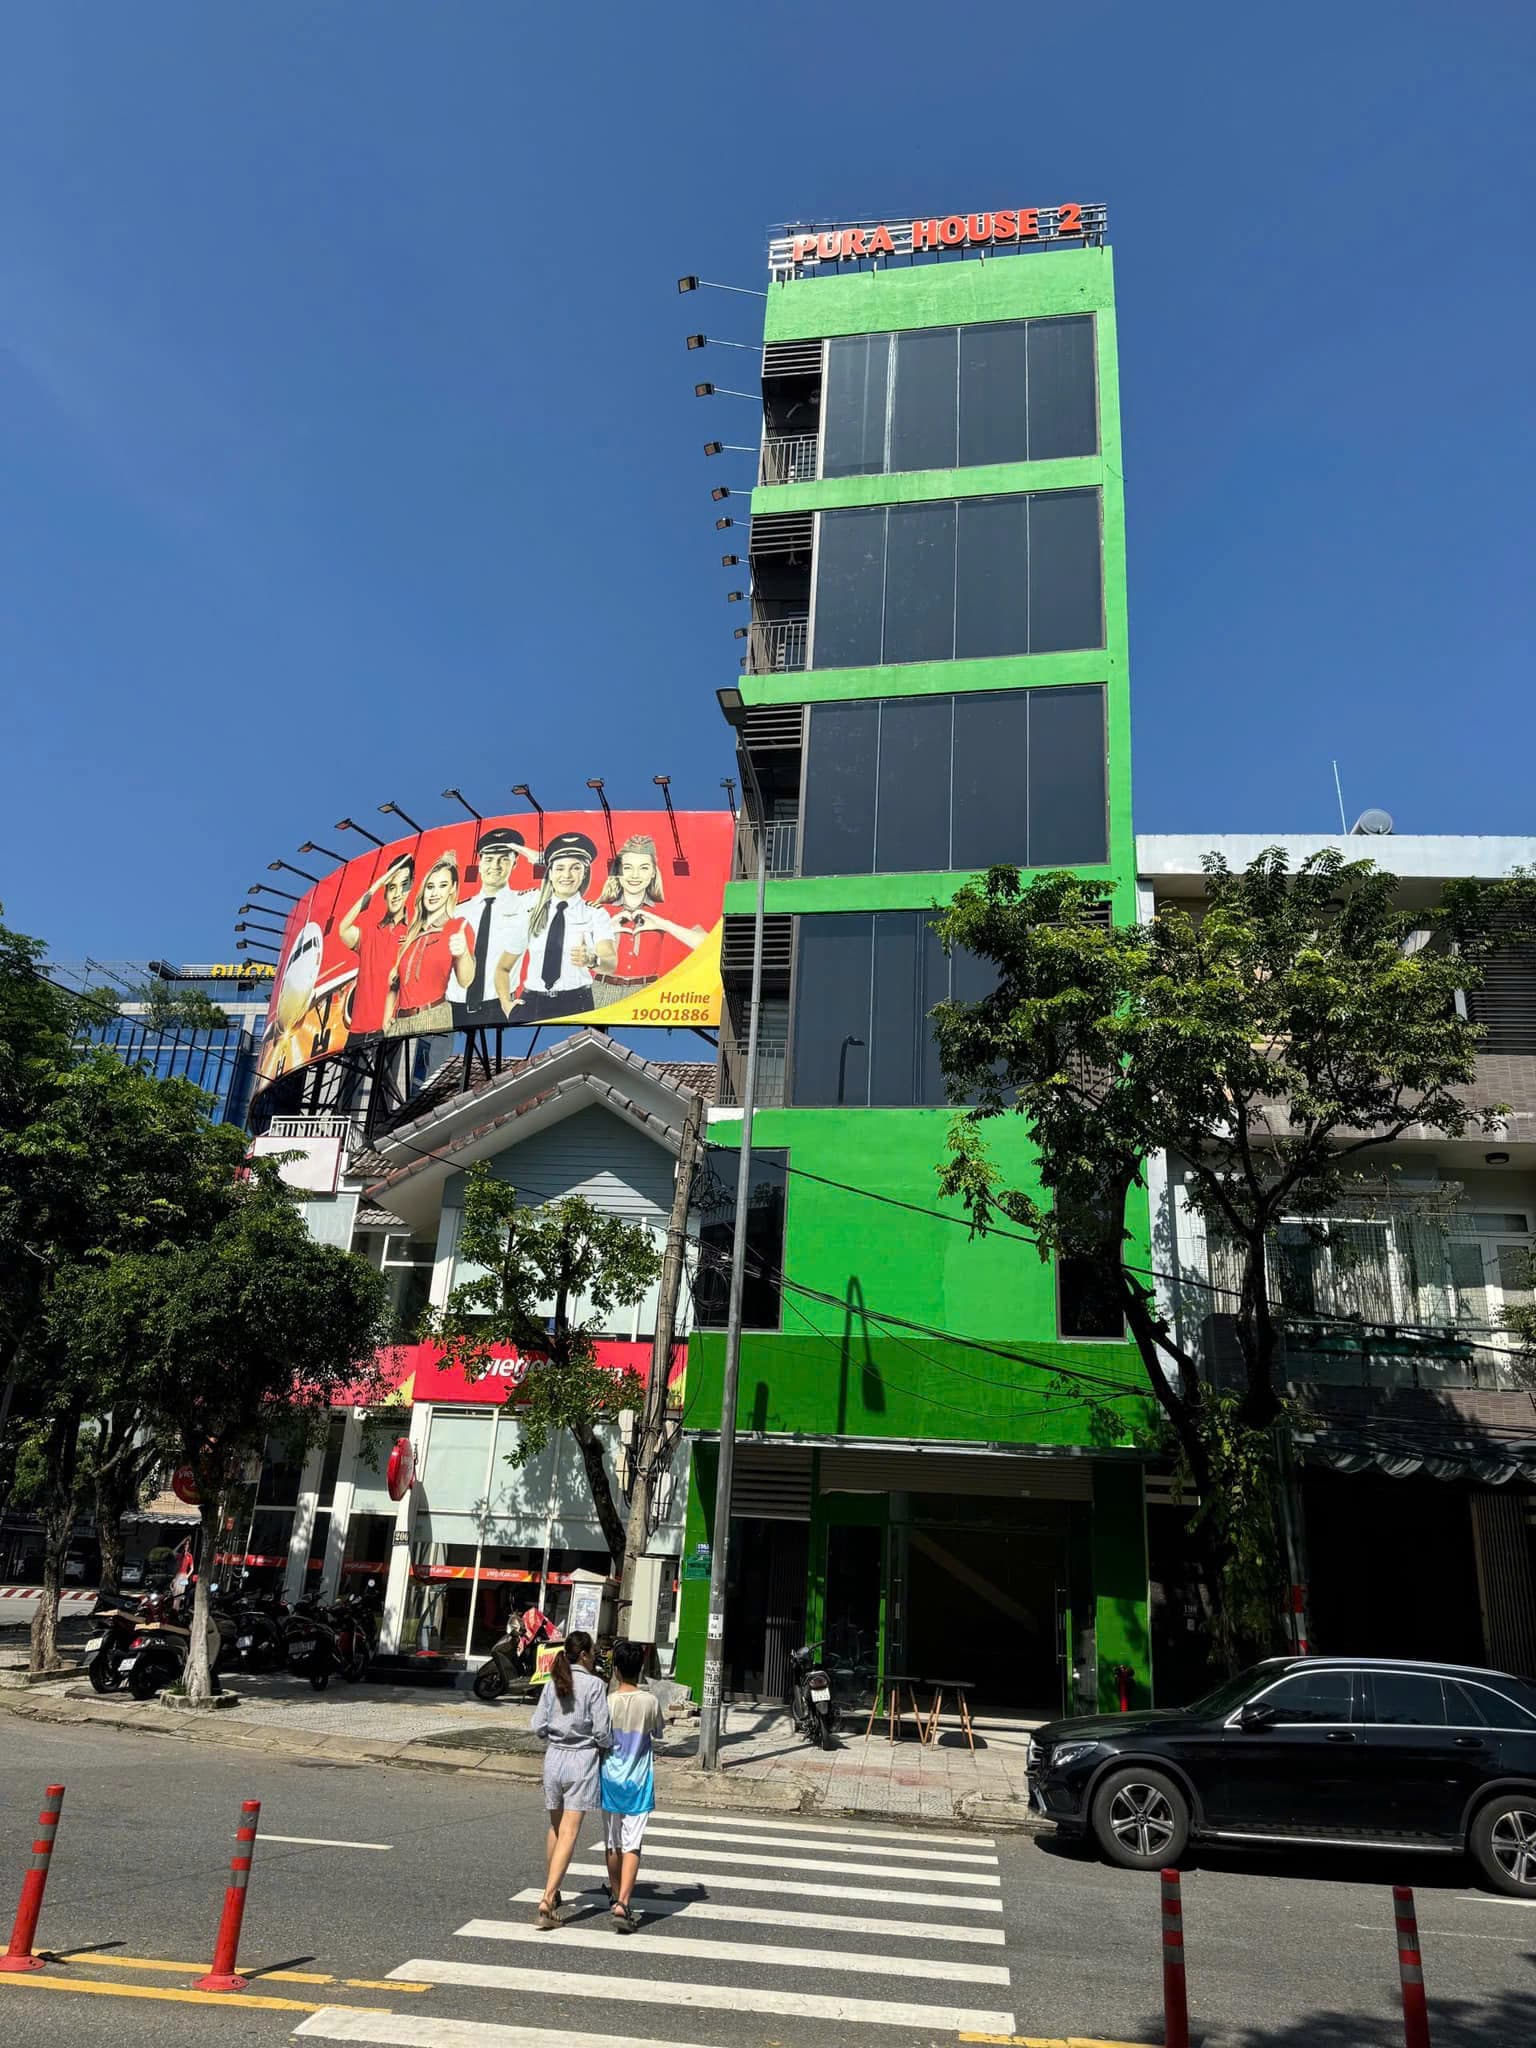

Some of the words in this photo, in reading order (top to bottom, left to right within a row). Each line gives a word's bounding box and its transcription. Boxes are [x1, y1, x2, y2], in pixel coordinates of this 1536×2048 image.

[792, 226, 895, 262] PURA
[912, 208, 1039, 247] HOUSE
[1057, 203, 1083, 232] 2
[660, 992, 710, 1004] Hotline
[631, 1008, 709, 1021] 19001886
